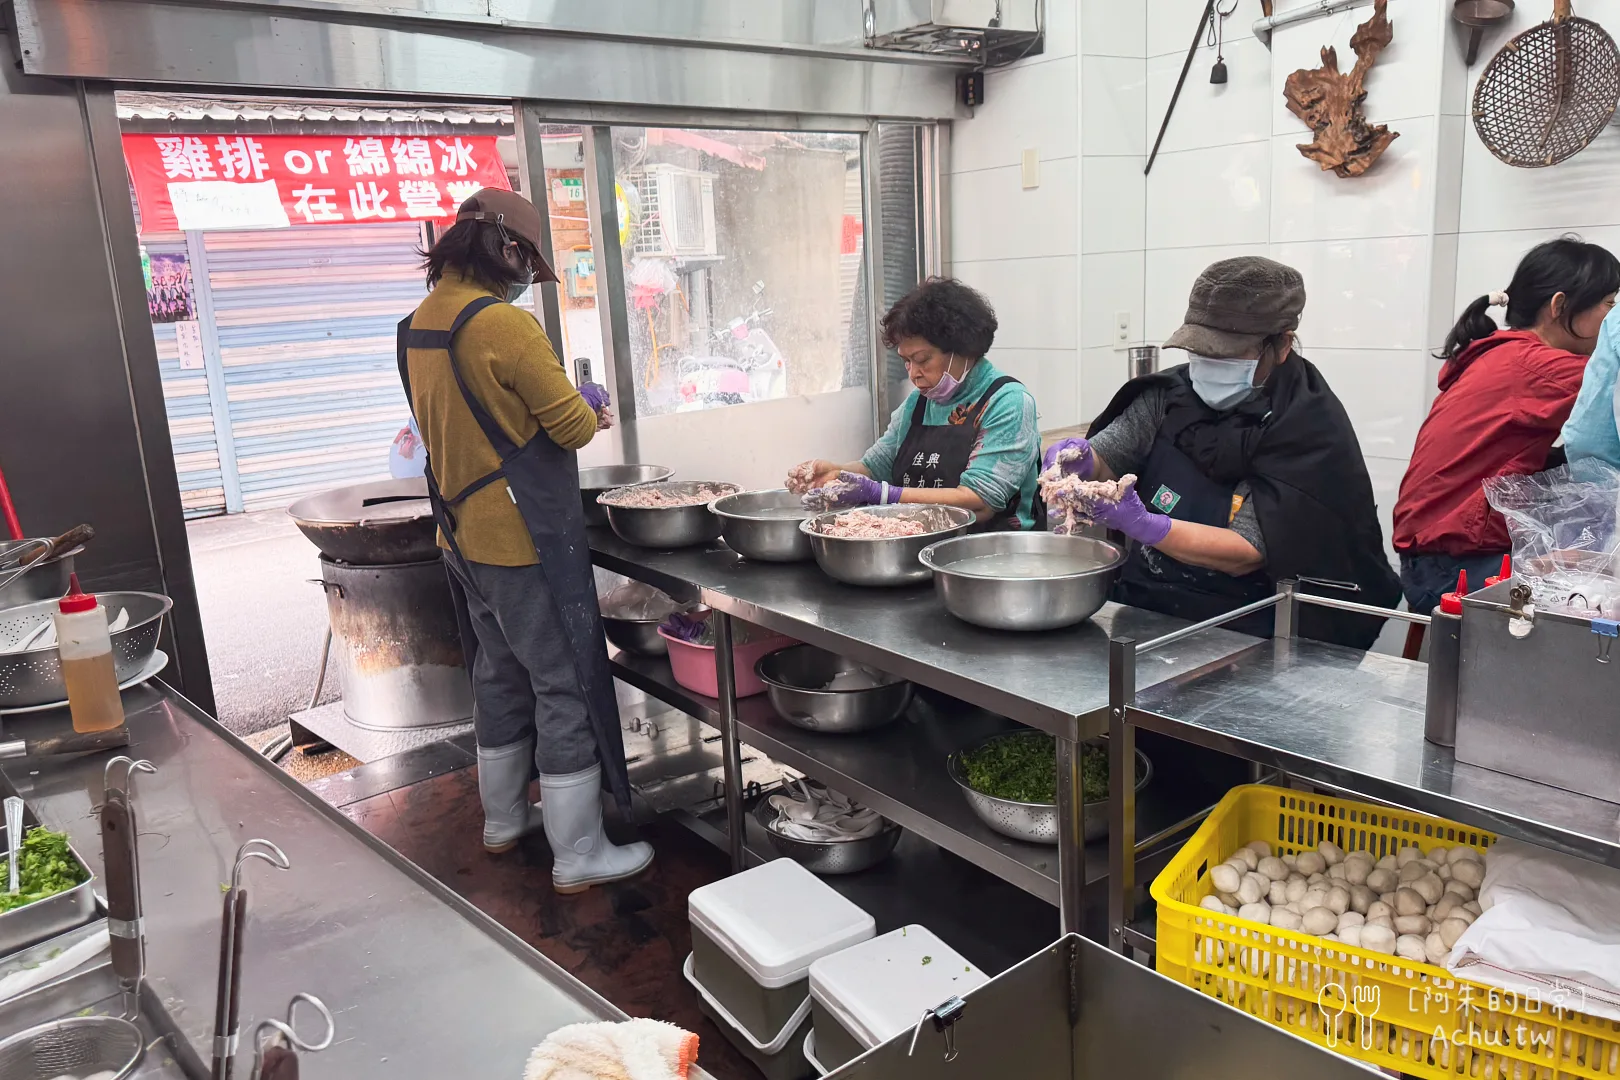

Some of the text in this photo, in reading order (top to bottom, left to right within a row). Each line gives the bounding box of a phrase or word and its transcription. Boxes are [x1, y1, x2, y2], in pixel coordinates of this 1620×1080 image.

[154, 136, 478, 179] 雞排 or 綿綿冰
[911, 451, 941, 469] 佳興
